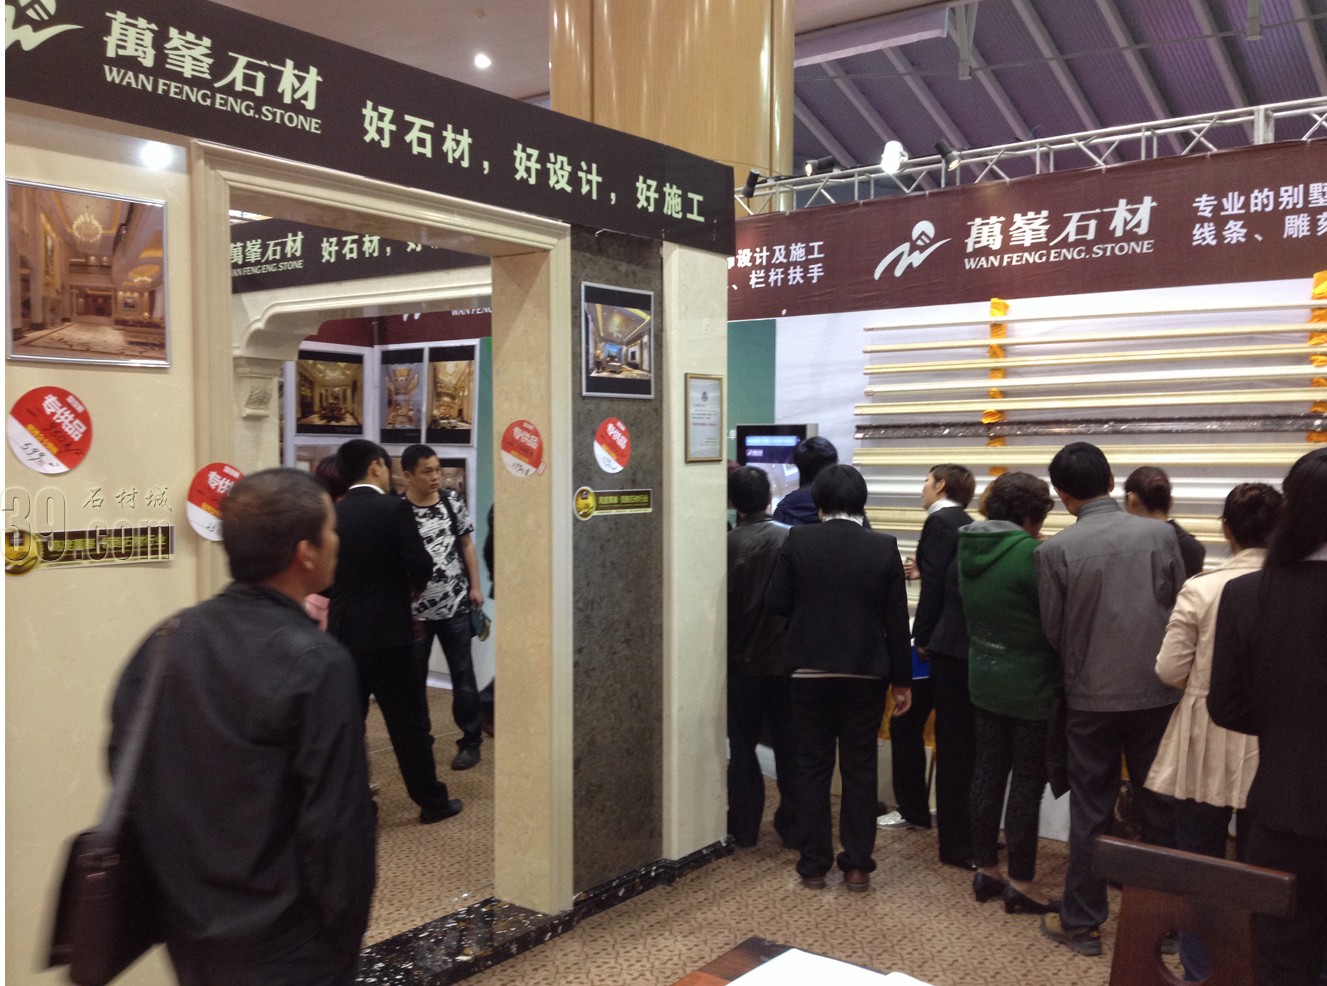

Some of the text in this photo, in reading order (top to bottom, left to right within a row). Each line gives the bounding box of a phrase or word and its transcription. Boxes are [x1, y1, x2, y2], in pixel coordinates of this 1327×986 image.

[103, 10, 323, 111] 萬峯石材
[103, 64, 322, 134] WAN FENG ENG. STONE
[965, 196, 1158, 253] 萬峯石材
[279, 260, 304, 271] STONE
[964, 239, 1154, 270] WAN FENG ENG. STONE
[42, 394, 87, 441] 专供品
[208, 470, 234, 494] 专供
